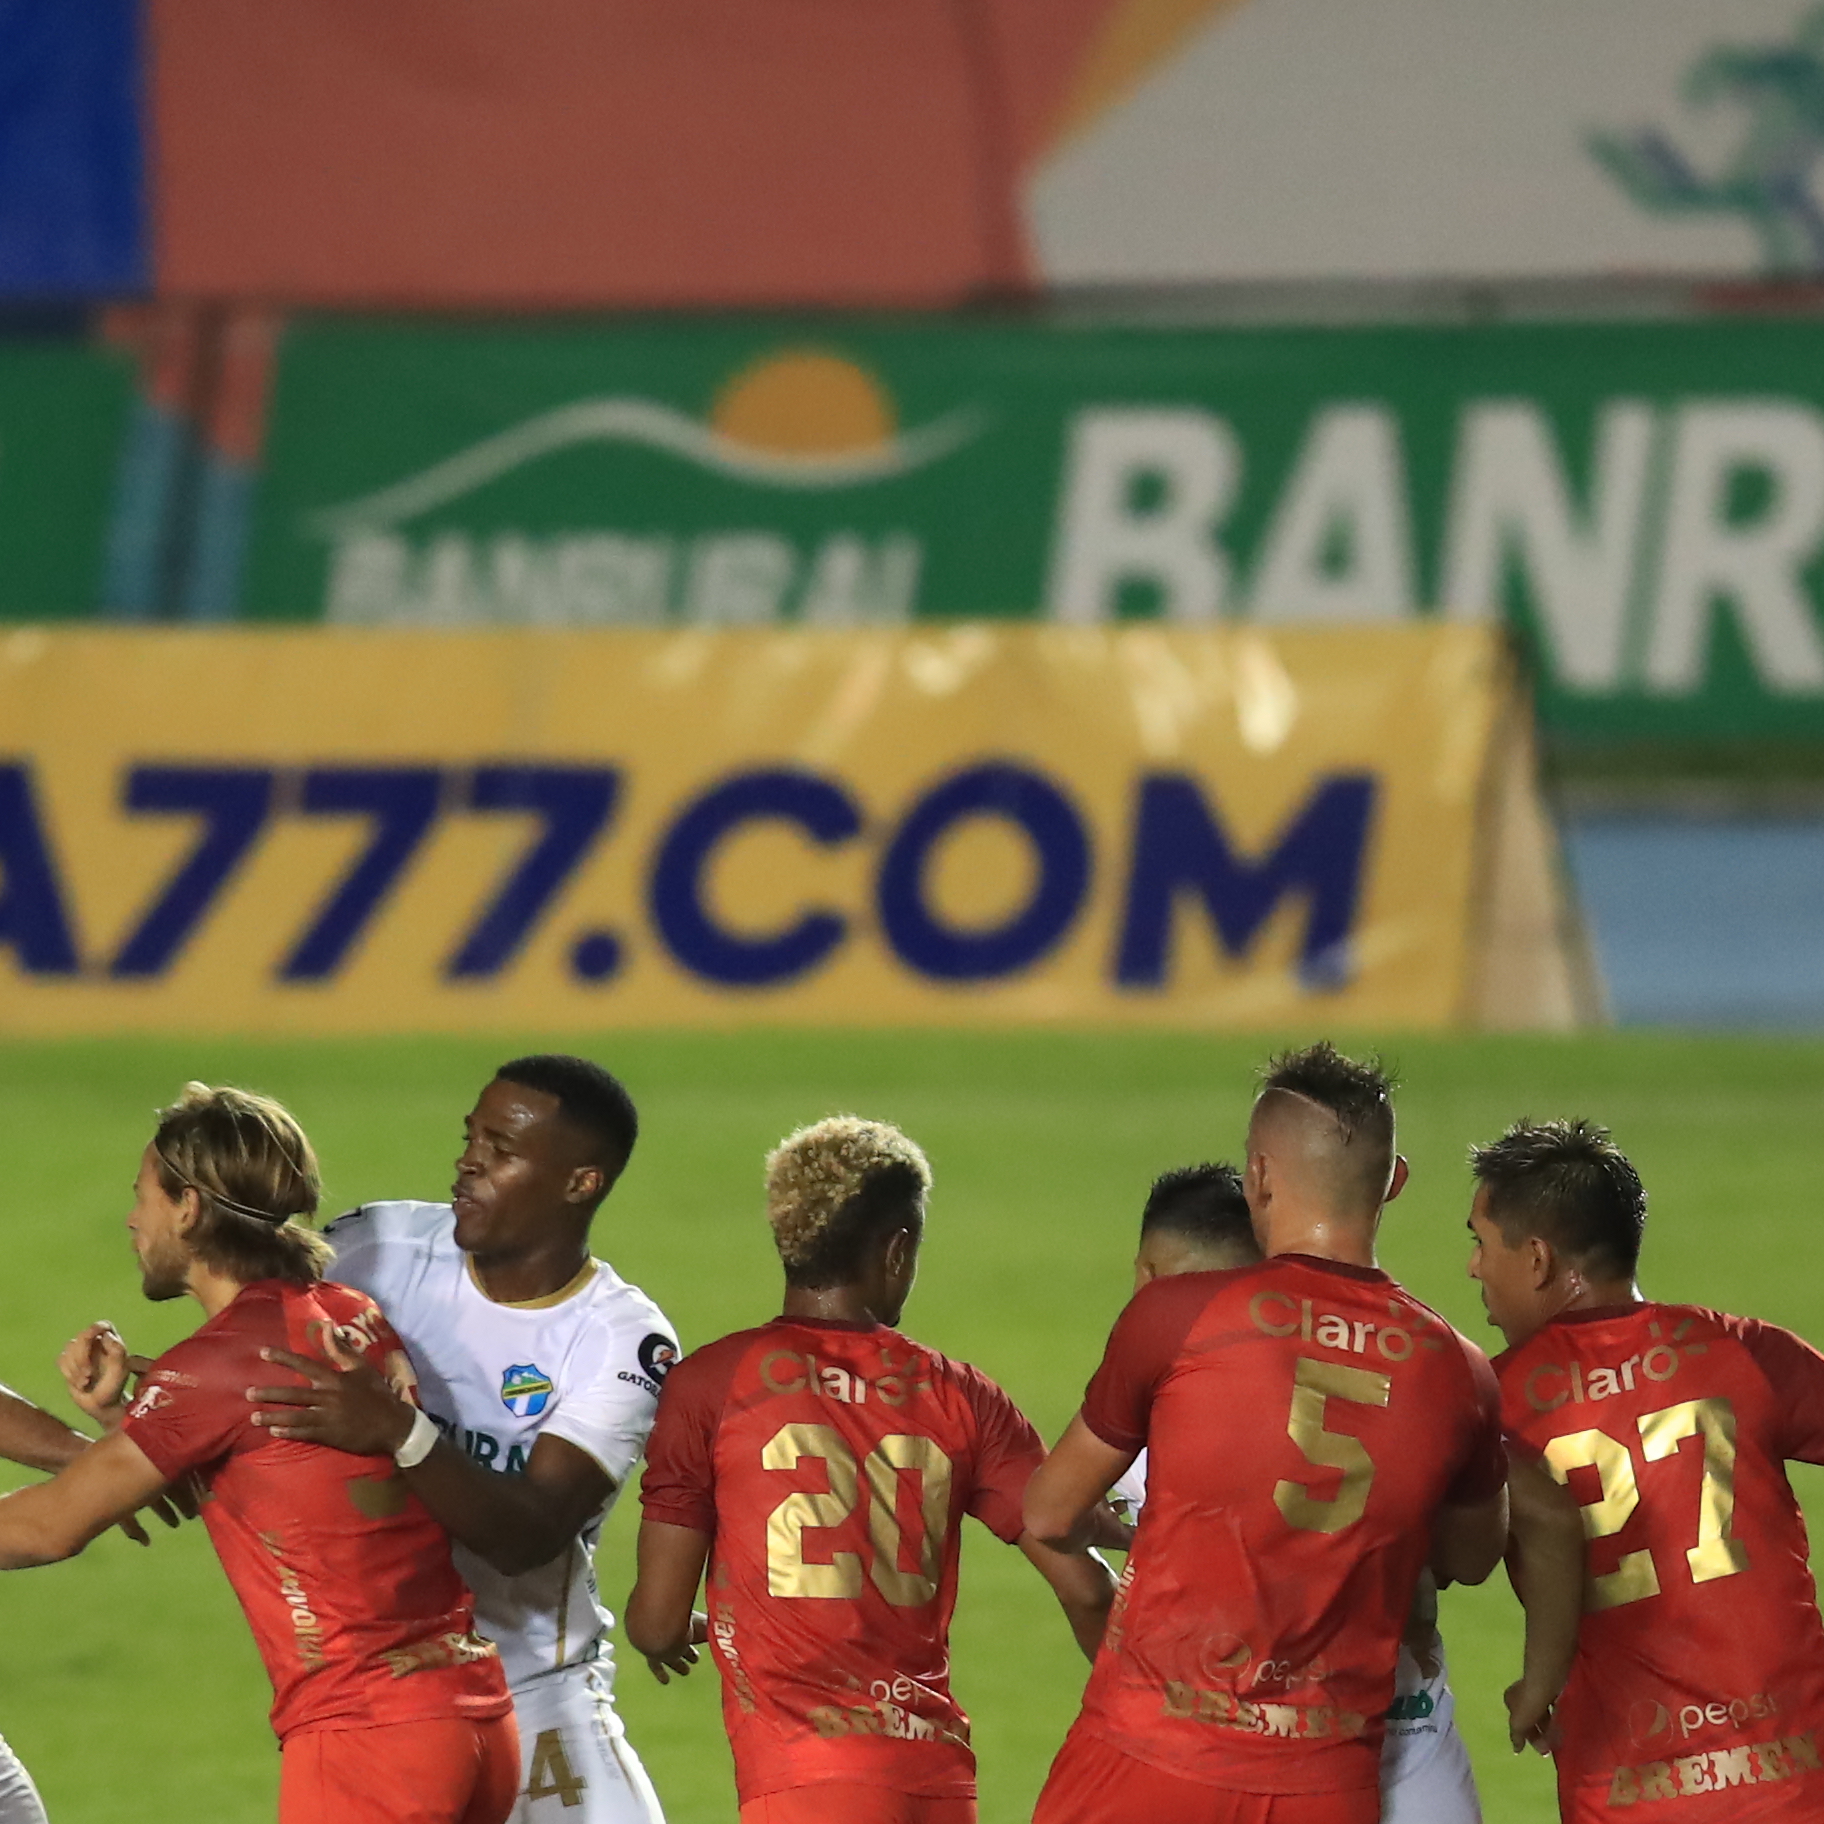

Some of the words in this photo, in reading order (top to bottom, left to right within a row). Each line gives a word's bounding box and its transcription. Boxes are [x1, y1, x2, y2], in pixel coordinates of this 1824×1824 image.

[1249, 1290, 1414, 1362] Claro
[617, 1371, 661, 1399] GATOR
[759, 1349, 908, 1407] Claro
[1525, 1344, 1679, 1413] Claro
[1273, 1356, 1392, 1534] 5
[761, 1423, 954, 1607] 20
[1540, 1397, 1752, 1616] 27
[1679, 1693, 1777, 1740] pepsi
[526, 1727, 589, 1808] 4
[1606, 1729, 1824, 1808] BREMEN
